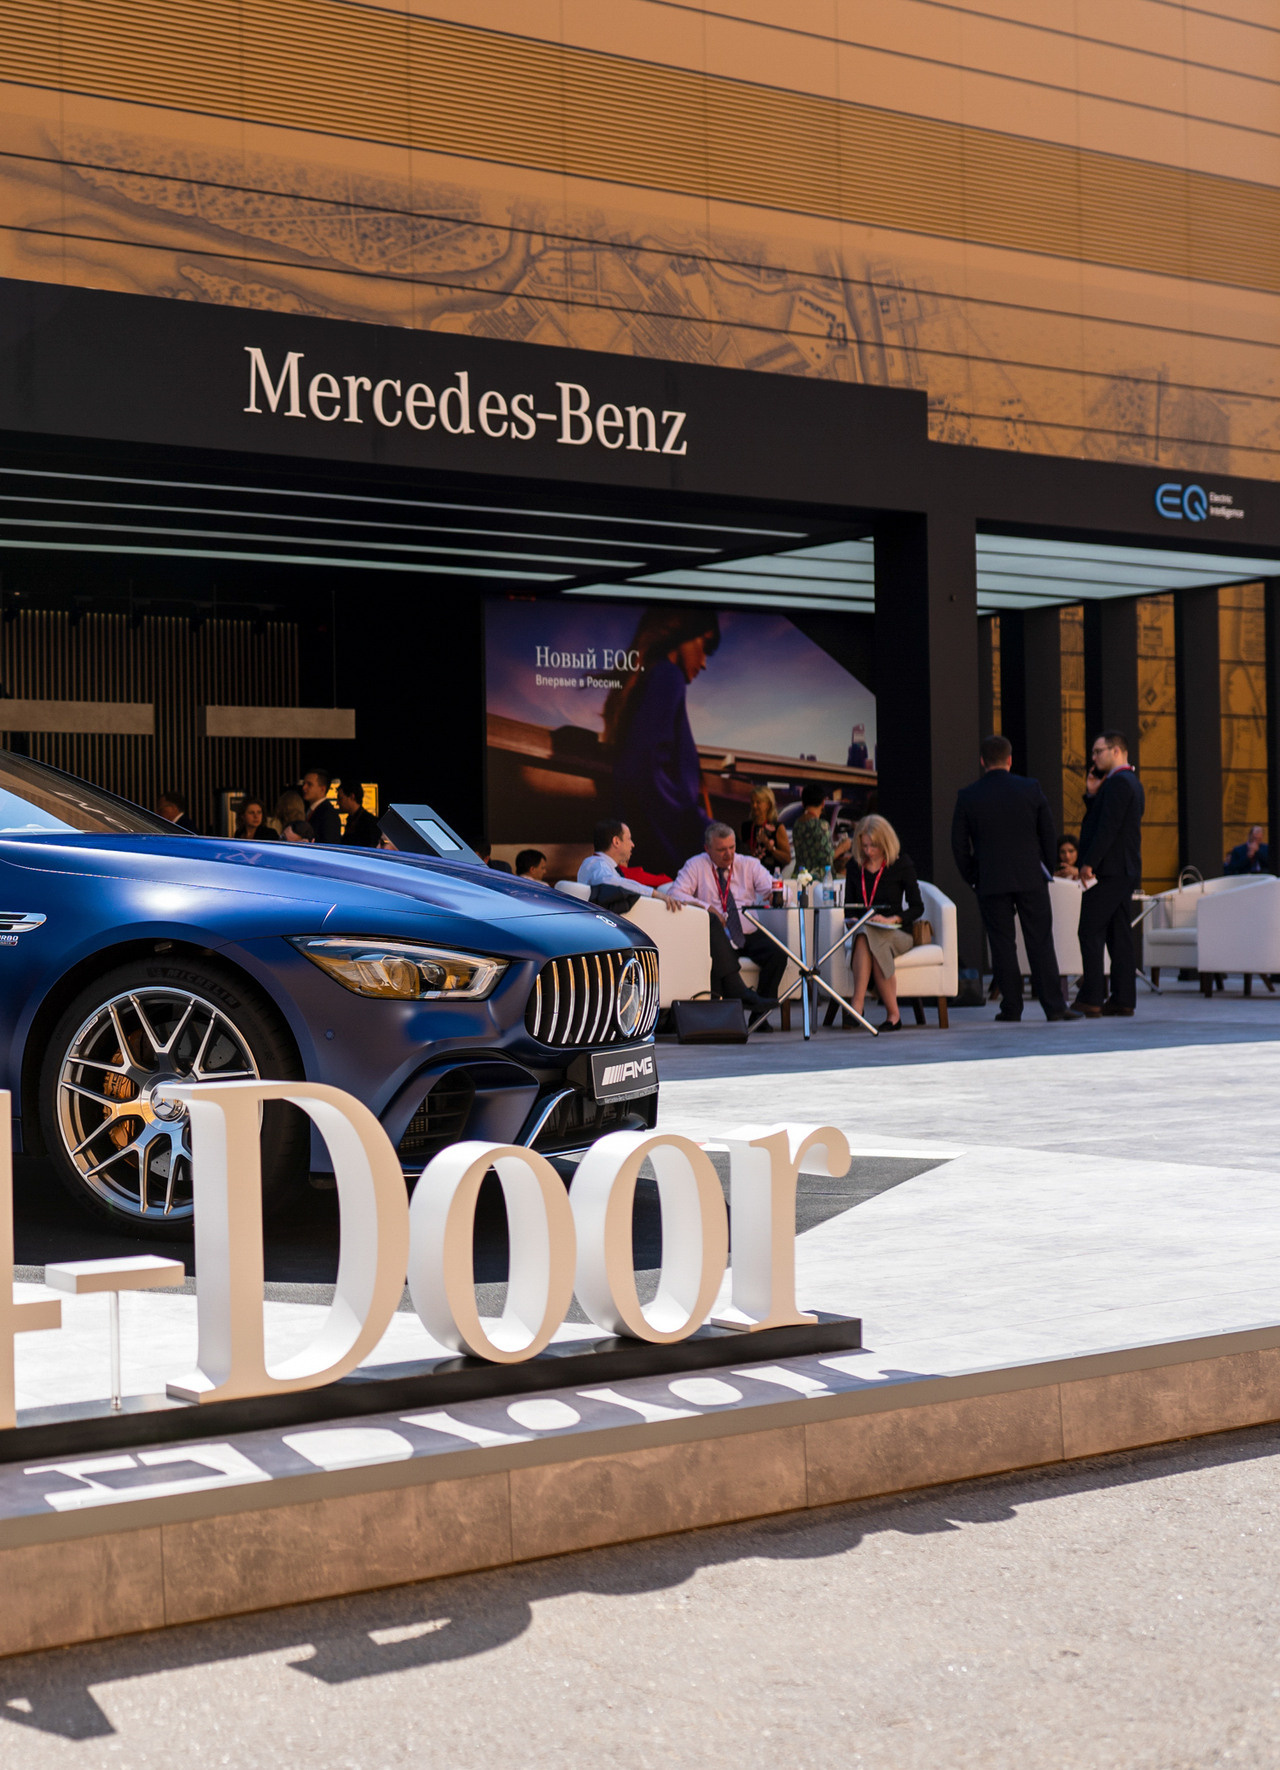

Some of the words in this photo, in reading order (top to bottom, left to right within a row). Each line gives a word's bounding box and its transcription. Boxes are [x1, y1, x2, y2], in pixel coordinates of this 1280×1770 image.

[243, 346, 688, 455] Mercedes-Benz
[1154, 482, 1207, 522] EQ
[535, 645, 597, 670] Новый
[535, 673, 577, 689] Впервые
[587, 675, 623, 689] России.
[622, 1056, 653, 1081] AMG
